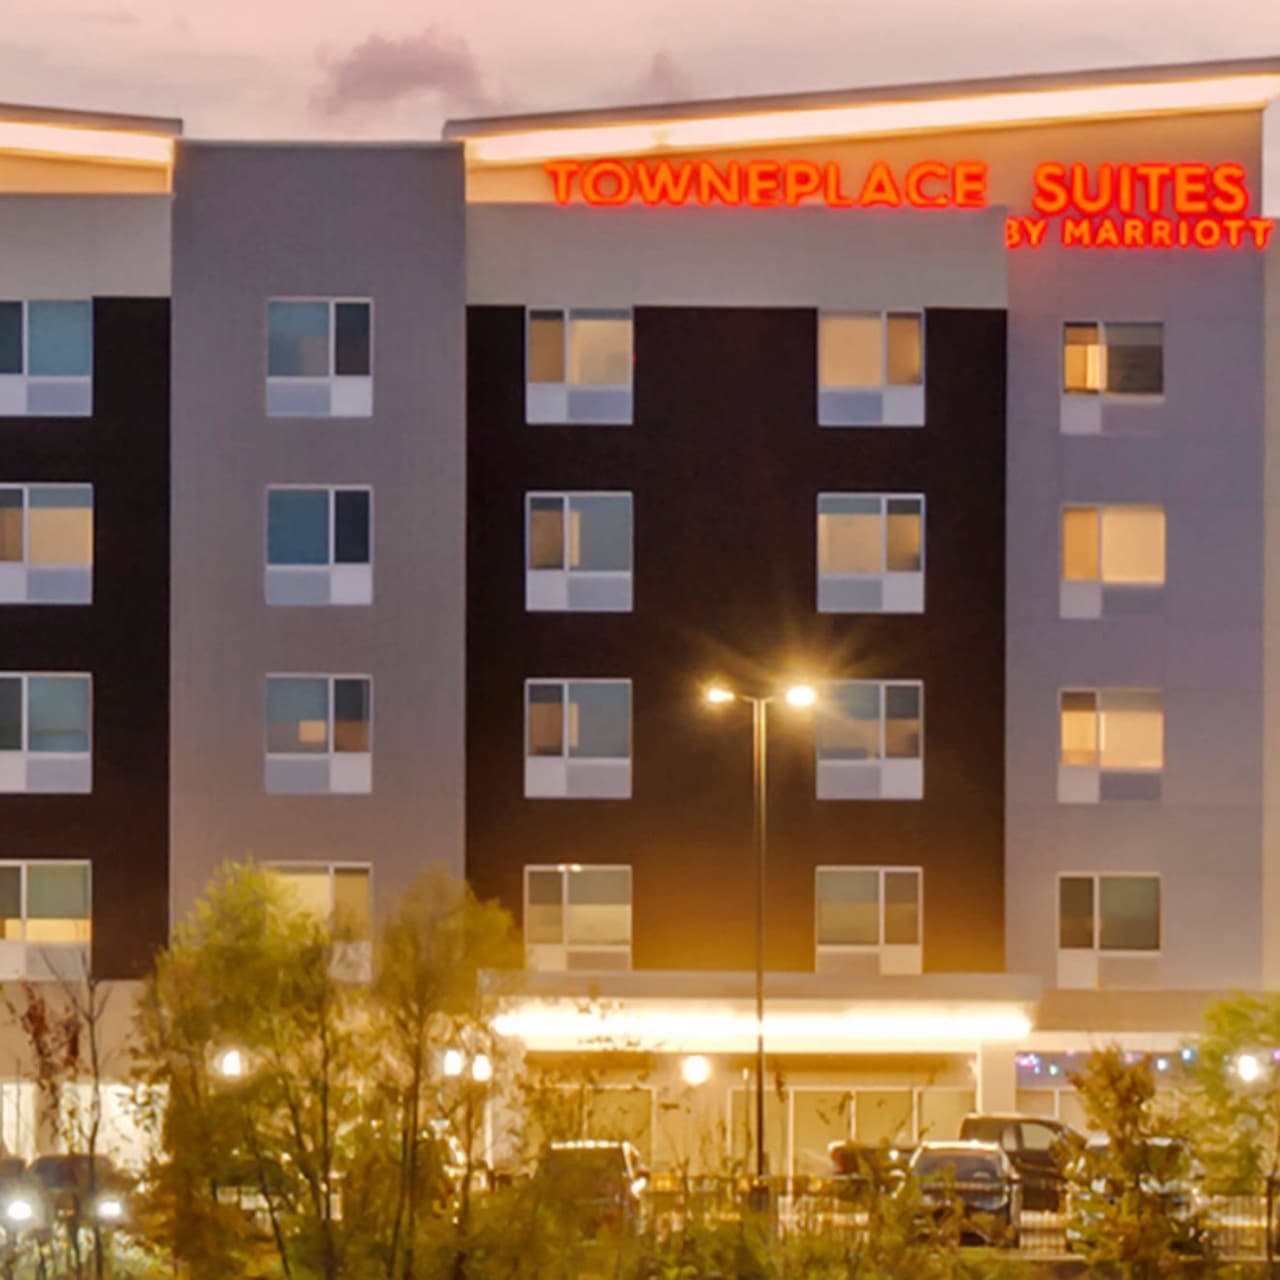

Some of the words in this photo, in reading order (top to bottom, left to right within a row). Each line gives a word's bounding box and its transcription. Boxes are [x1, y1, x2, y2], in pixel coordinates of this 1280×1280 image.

[547, 159, 989, 208] TOWNEPLACE
[1031, 162, 1248, 216] SUITES
[1005, 218, 1045, 248] BY
[1062, 218, 1274, 249] MARRIOTT
